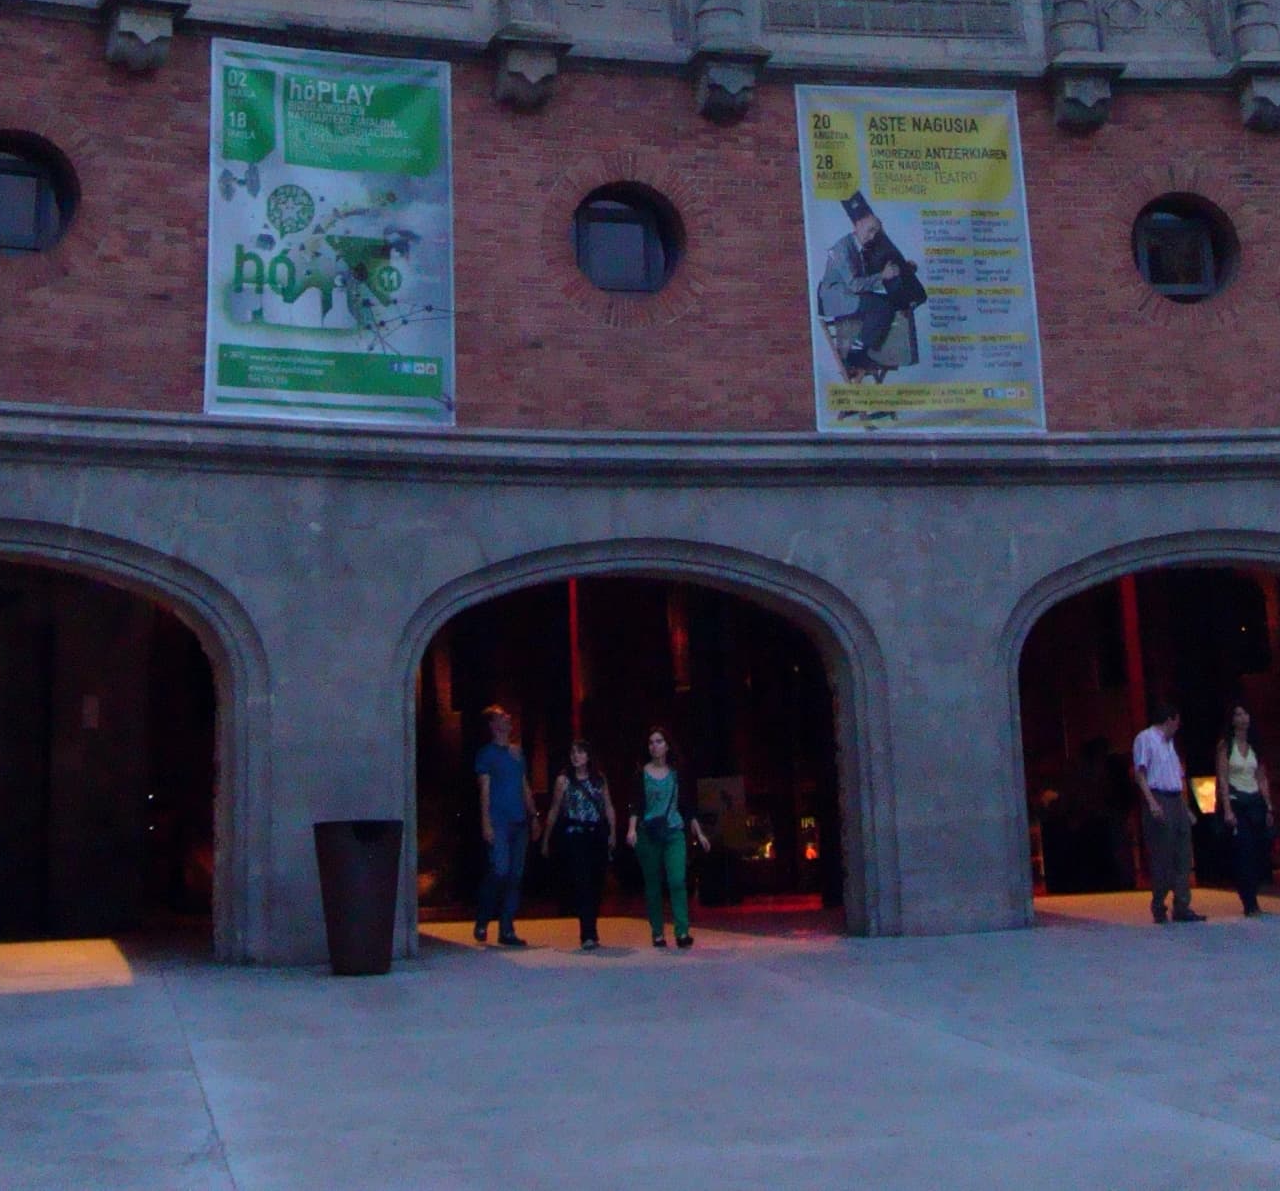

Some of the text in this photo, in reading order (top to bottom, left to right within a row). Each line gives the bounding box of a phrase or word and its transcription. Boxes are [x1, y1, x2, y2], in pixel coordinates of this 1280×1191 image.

[228, 69, 247, 87] 02
[289, 77, 375, 106] hóPLAY
[228, 111, 247, 128] 18
[813, 114, 831, 129] 20
[869, 116, 978, 133] ASTE NAGUSIA
[870, 133, 896, 146] 2011
[816, 154, 833, 170] 28
[872, 159, 941, 171] ASTE NAGUSIA
[935, 170, 977, 184] TEATRO
